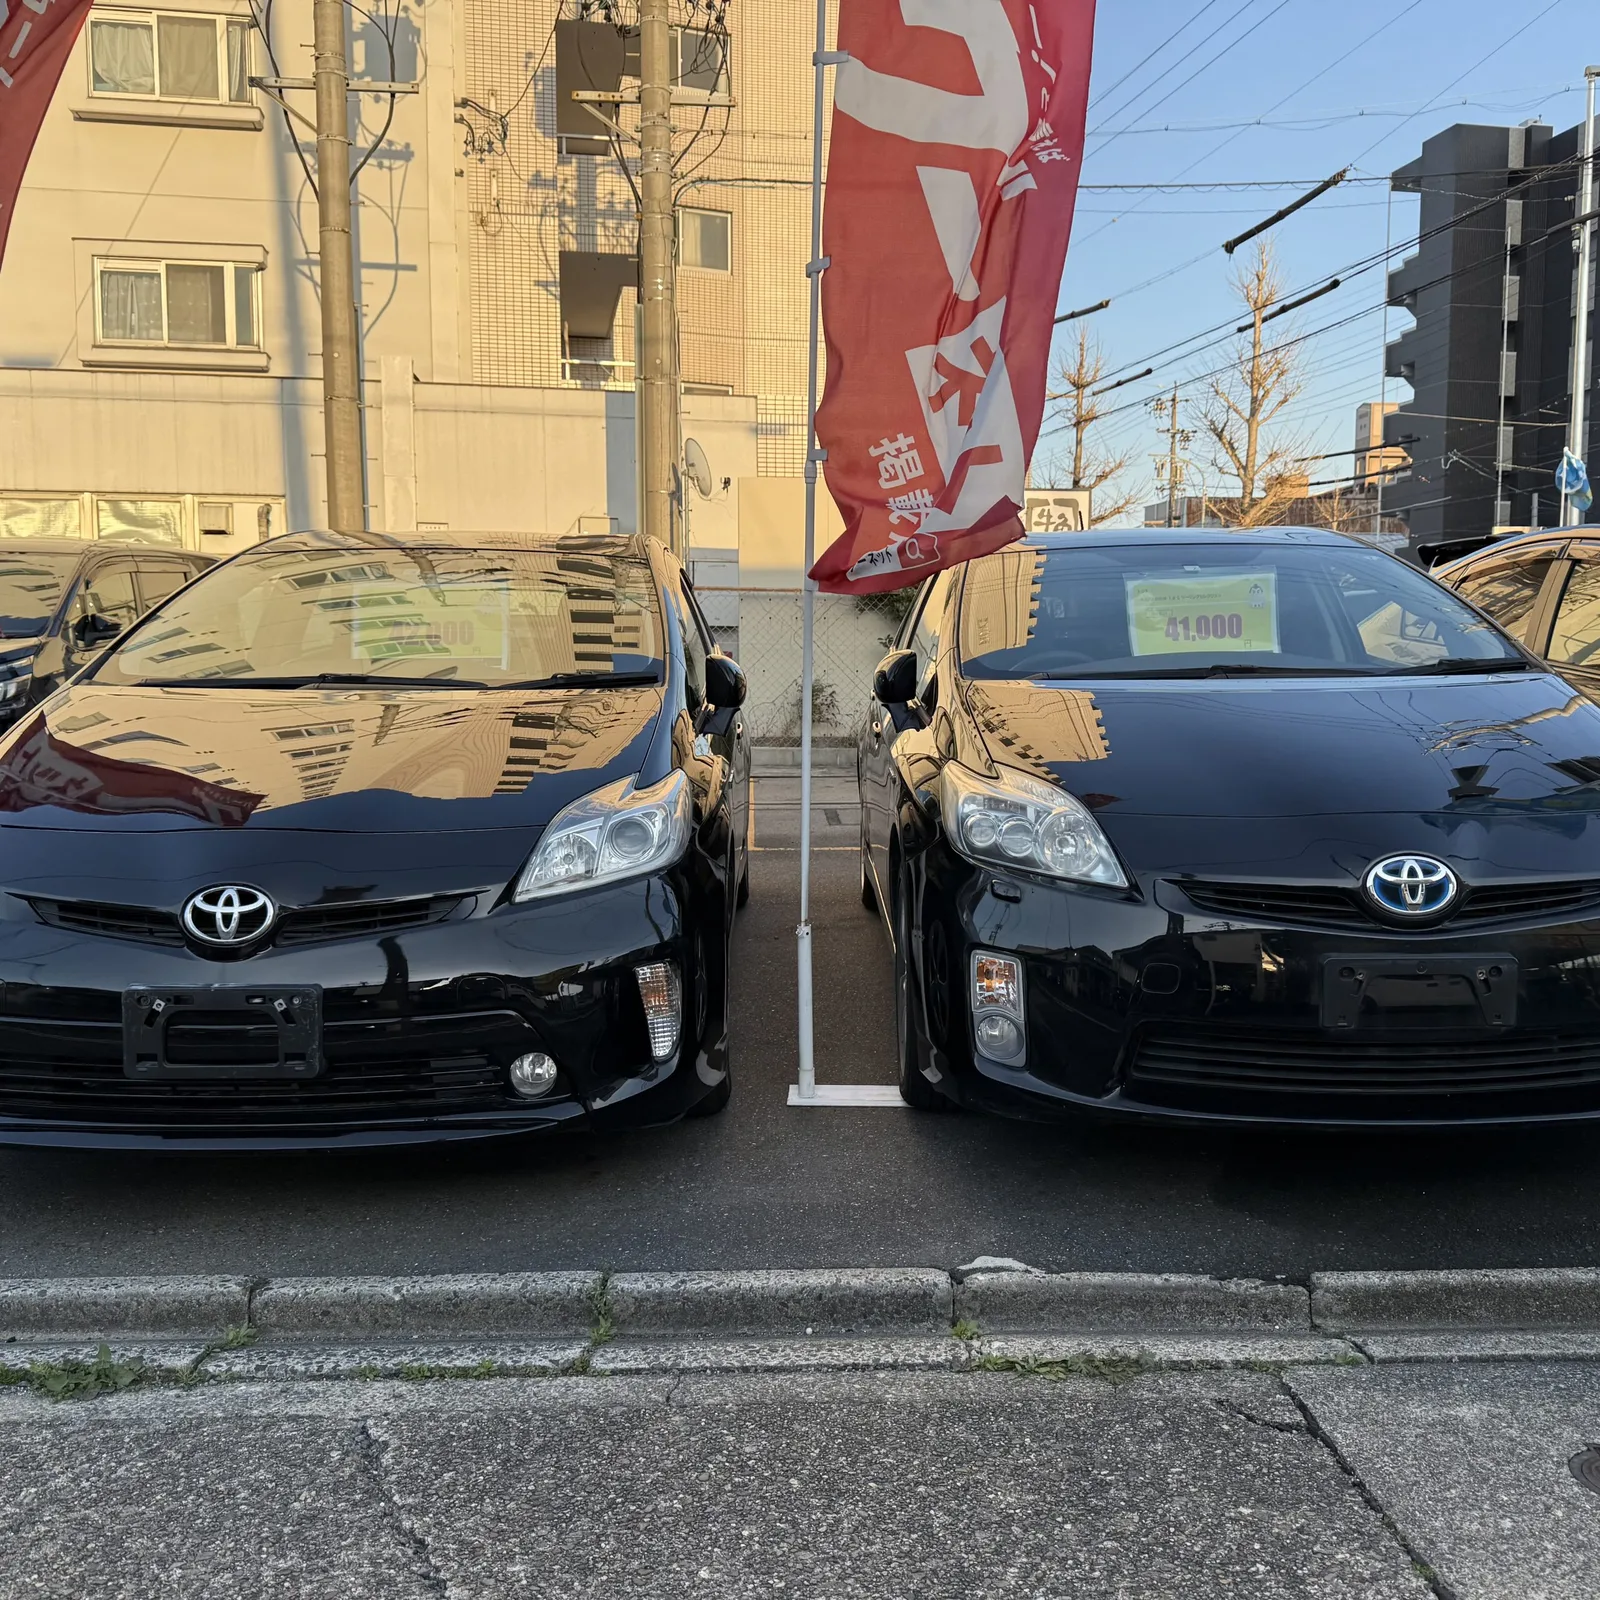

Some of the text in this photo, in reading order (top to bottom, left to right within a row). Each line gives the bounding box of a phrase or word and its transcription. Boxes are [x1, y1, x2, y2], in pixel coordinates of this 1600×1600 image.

[850, 547, 893, 573] ーネット
[1164, 613, 1243, 642] 41,000
